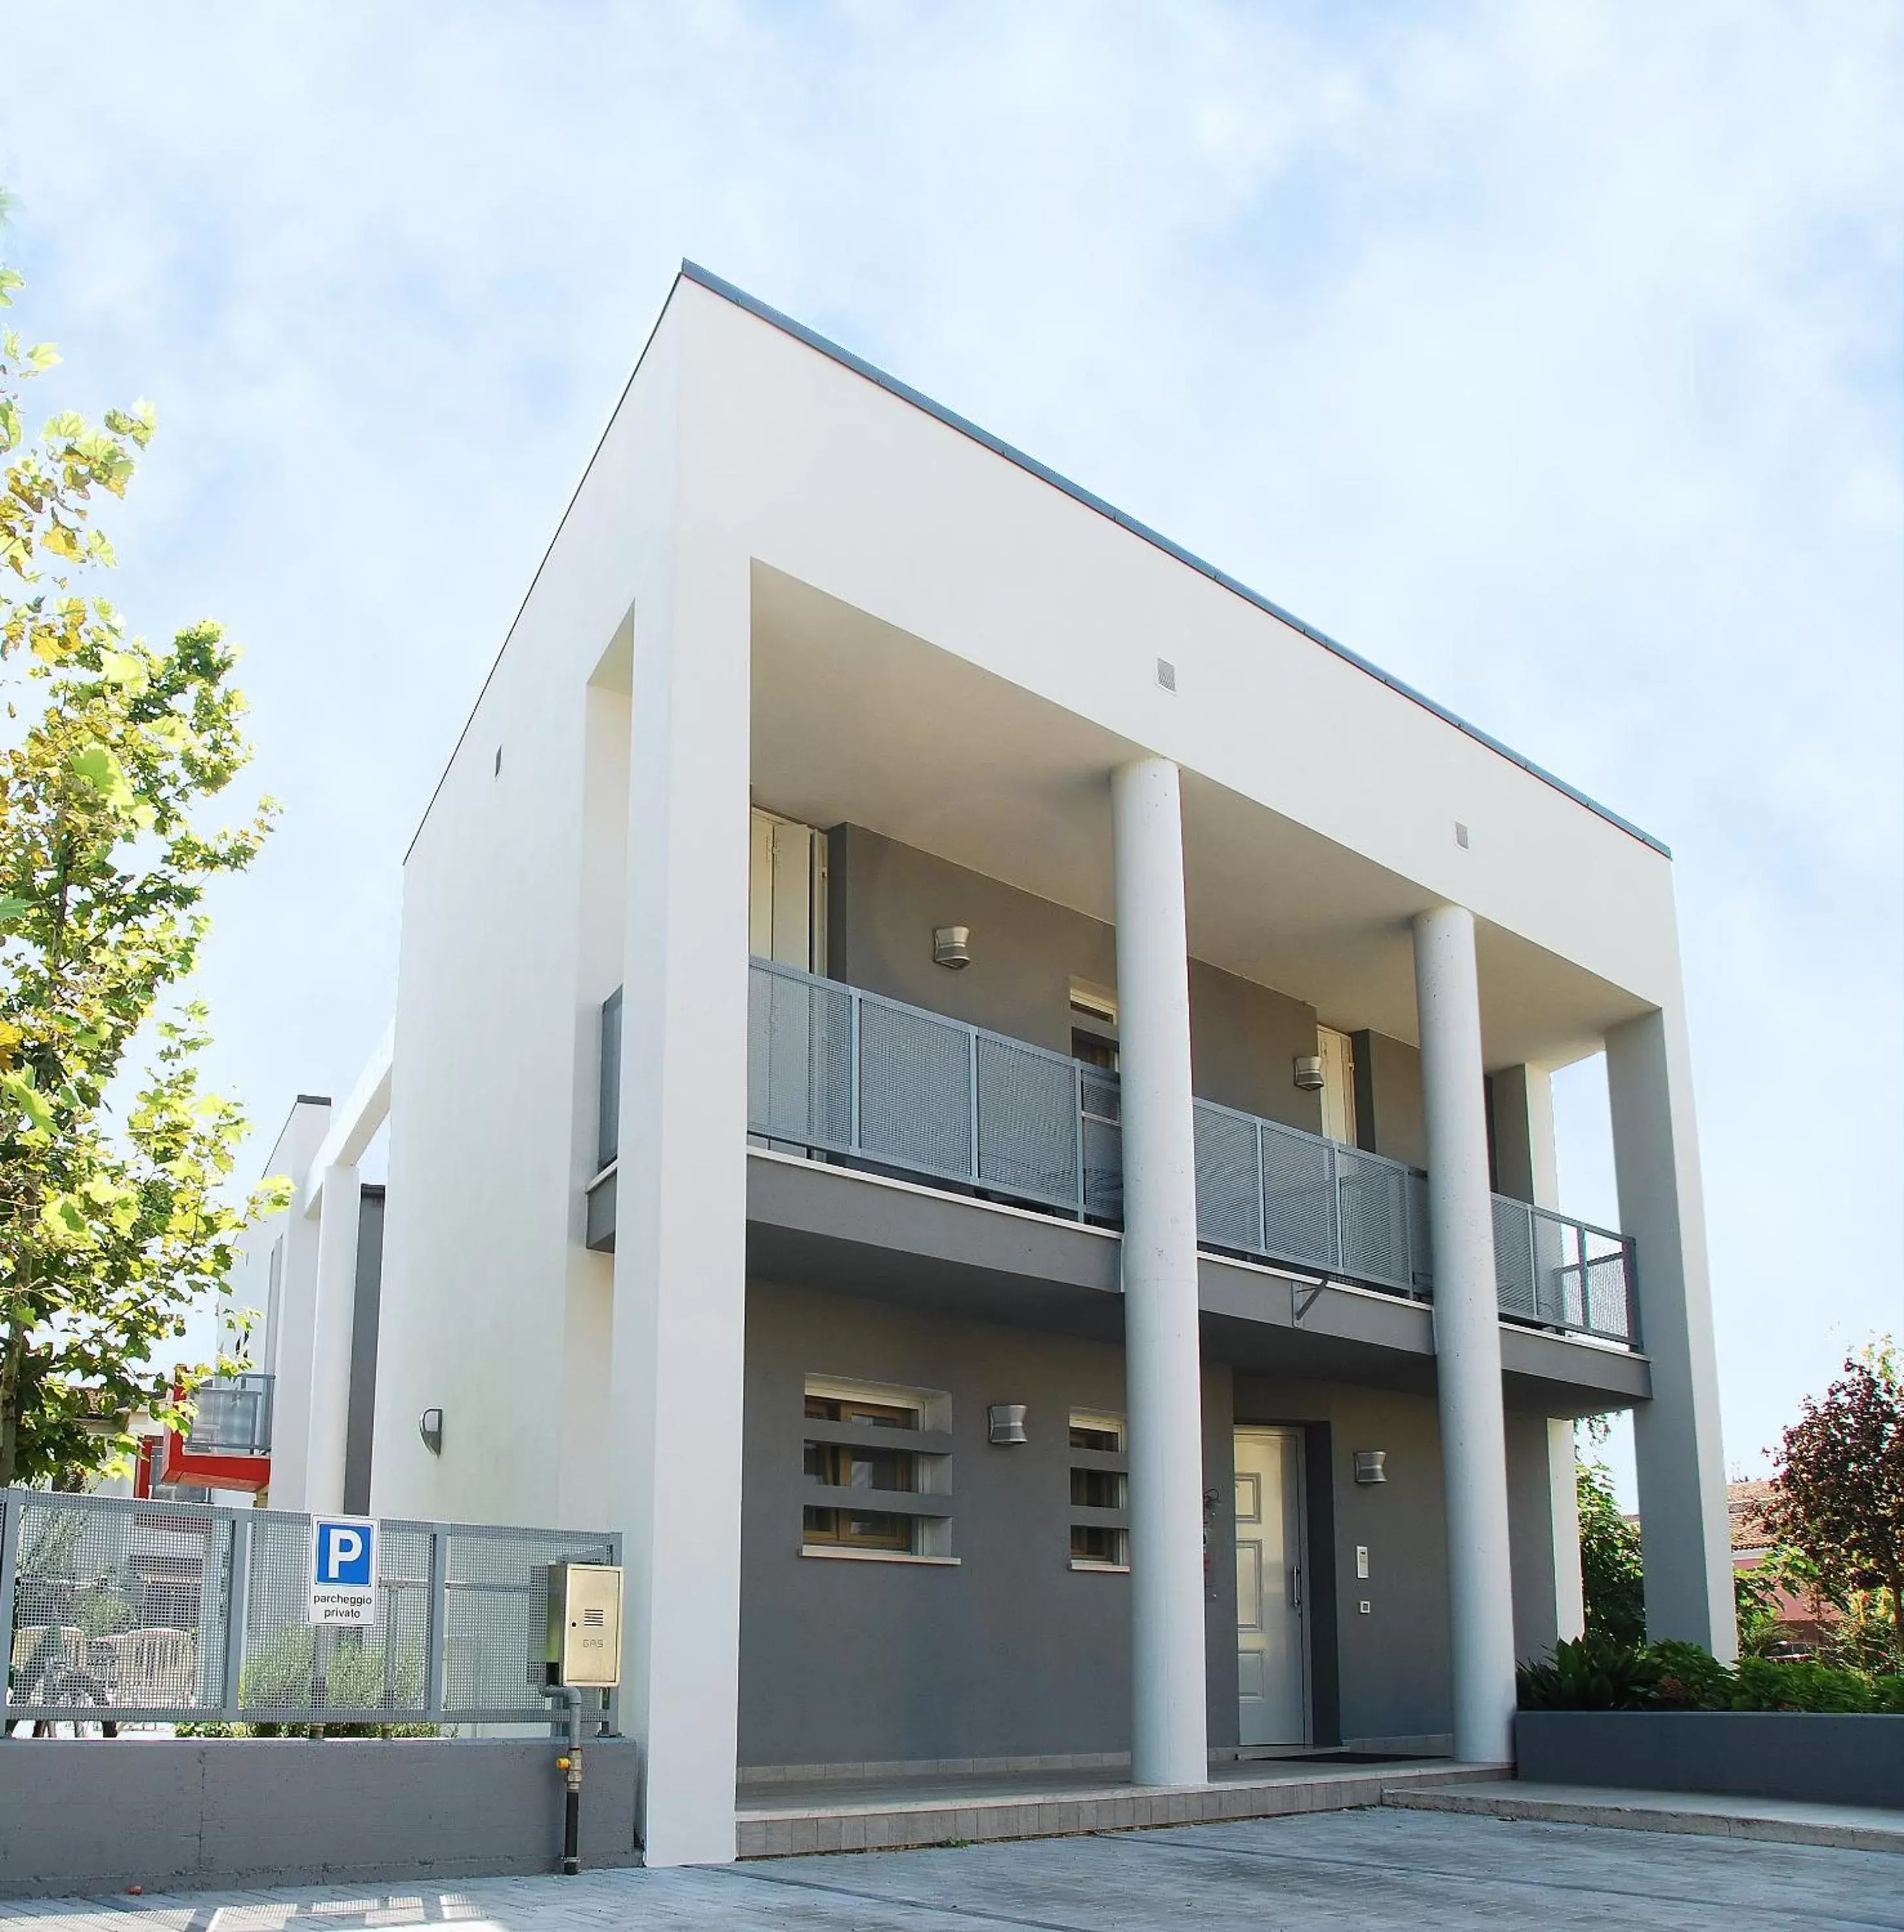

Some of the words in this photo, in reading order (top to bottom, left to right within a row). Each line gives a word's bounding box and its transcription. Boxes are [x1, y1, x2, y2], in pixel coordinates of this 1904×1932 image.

[328, 1528, 362, 1578] P
[313, 1593, 372, 1606] parcheggio
[324, 1607, 361, 1619] privato
[582, 1640, 604, 1648] GAS
